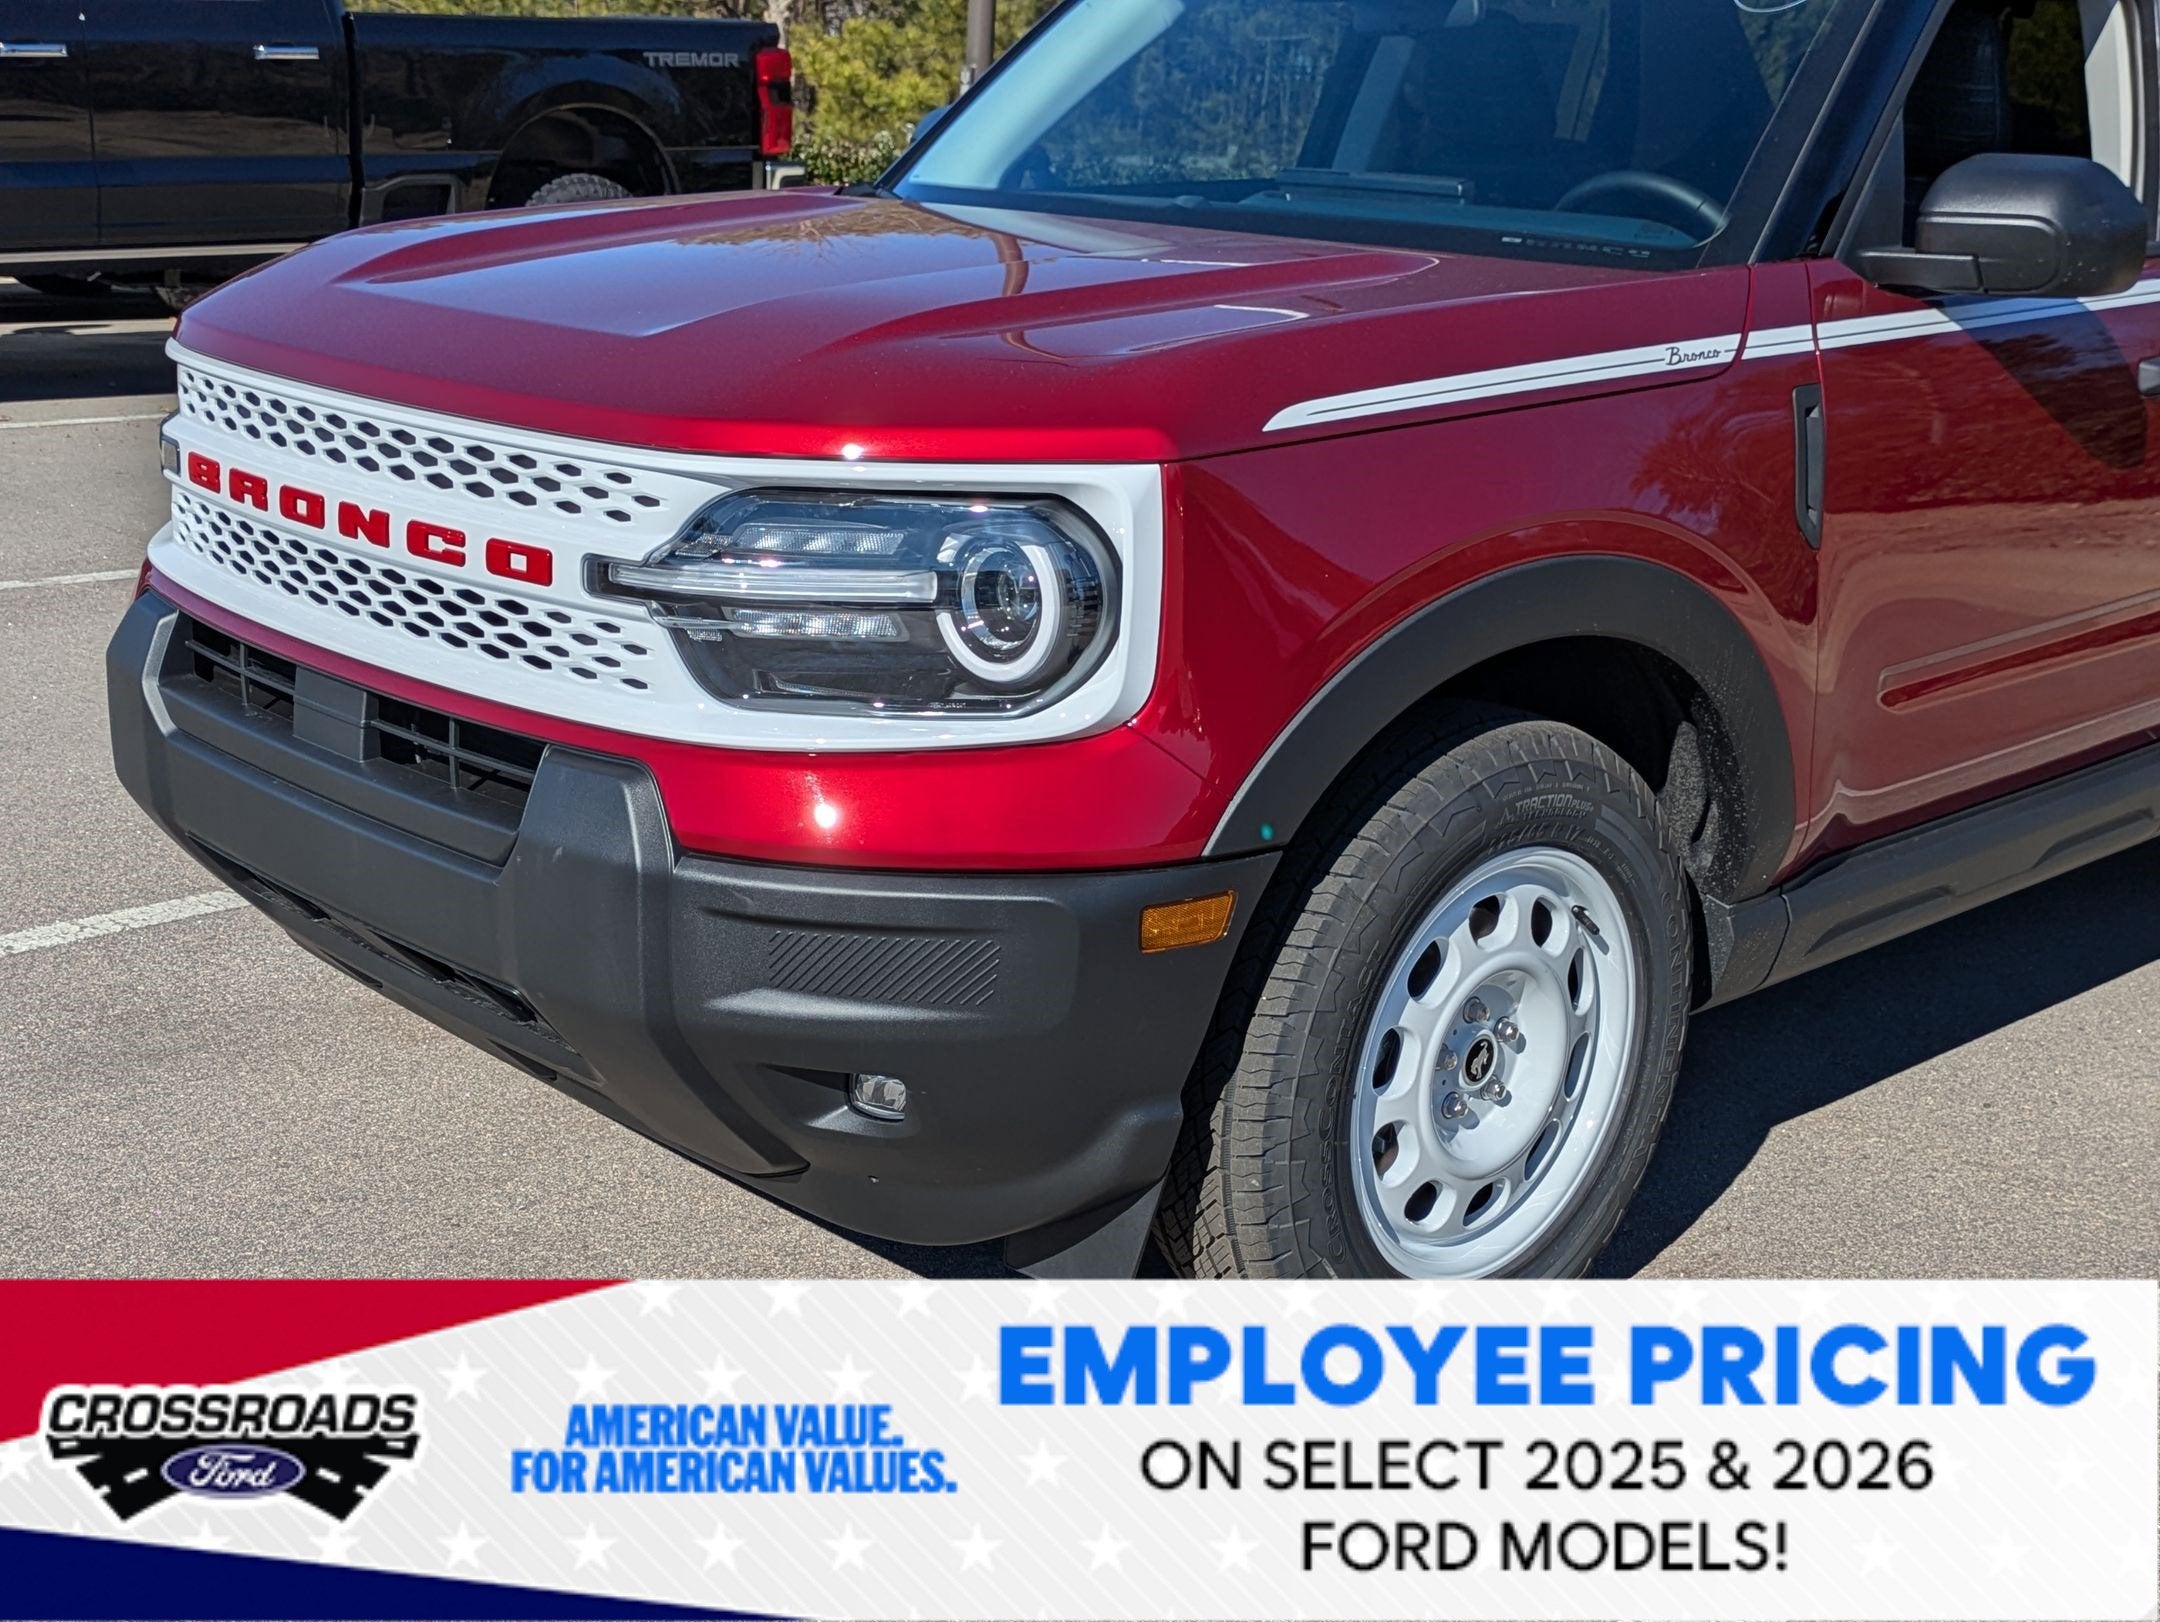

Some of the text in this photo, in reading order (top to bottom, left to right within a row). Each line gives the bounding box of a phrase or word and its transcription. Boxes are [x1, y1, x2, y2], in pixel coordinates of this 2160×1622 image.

[642, 51, 740, 68] TREMOR
[1665, 346, 1721, 366] Bronco
[187, 451, 553, 587] BRONCO
